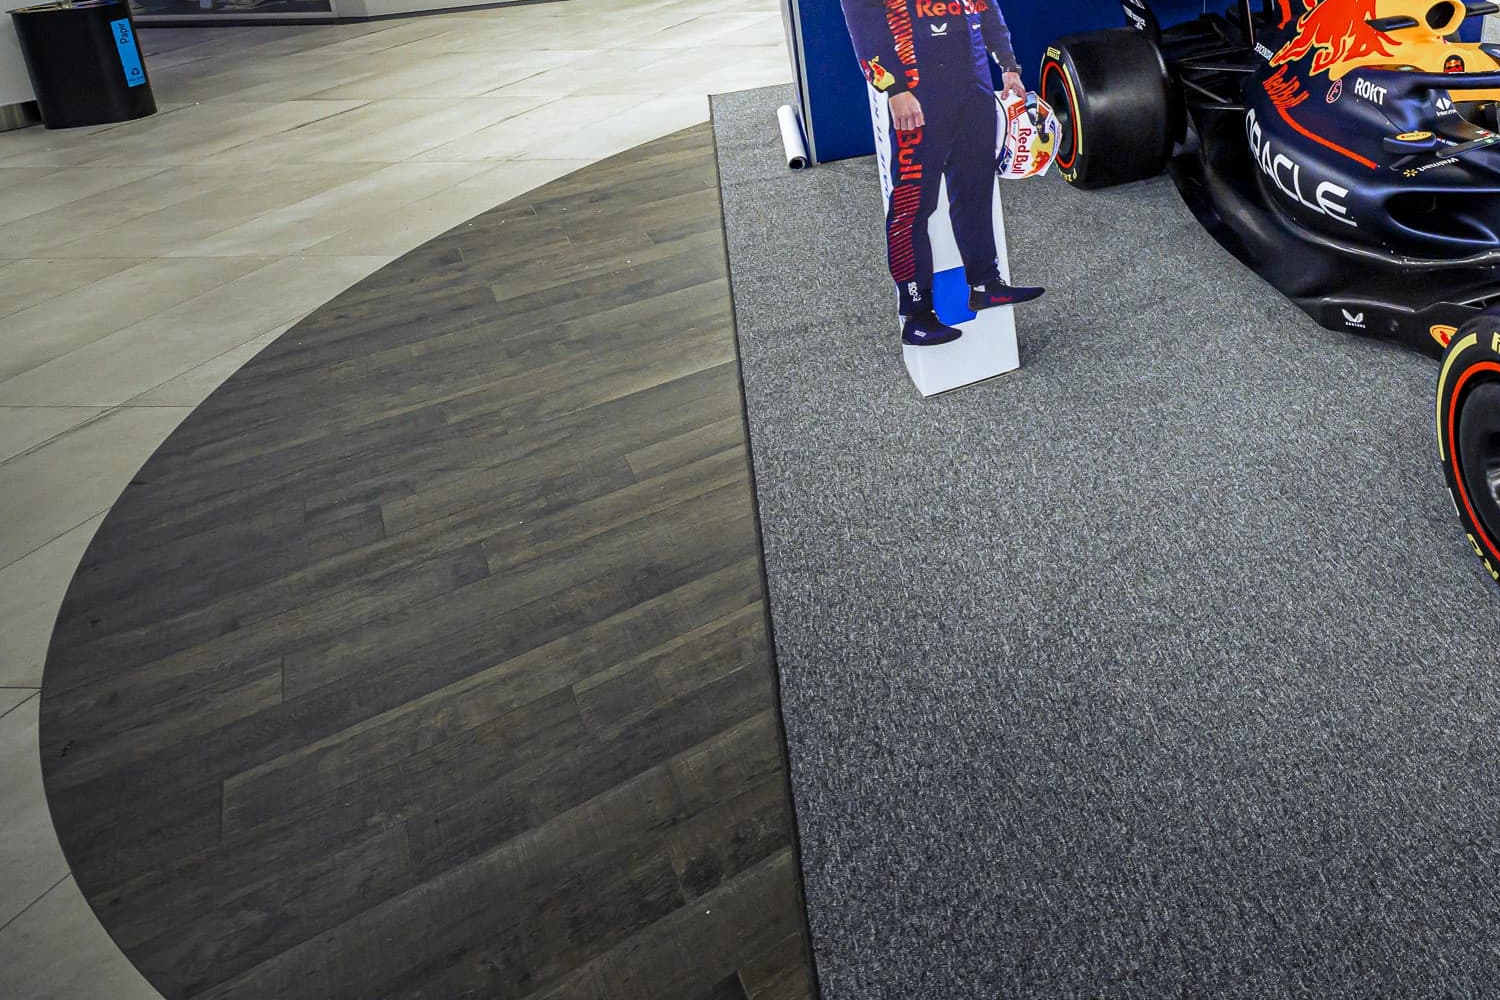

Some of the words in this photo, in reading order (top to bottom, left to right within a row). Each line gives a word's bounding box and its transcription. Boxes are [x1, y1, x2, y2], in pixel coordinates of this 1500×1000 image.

[118, 22, 131, 45] Papir
[1354, 77, 1387, 106] ROKT
[1018, 128, 1031, 153] Red
[1011, 155, 1029, 174] Bull
[1245, 108, 1358, 227] ORACLE
